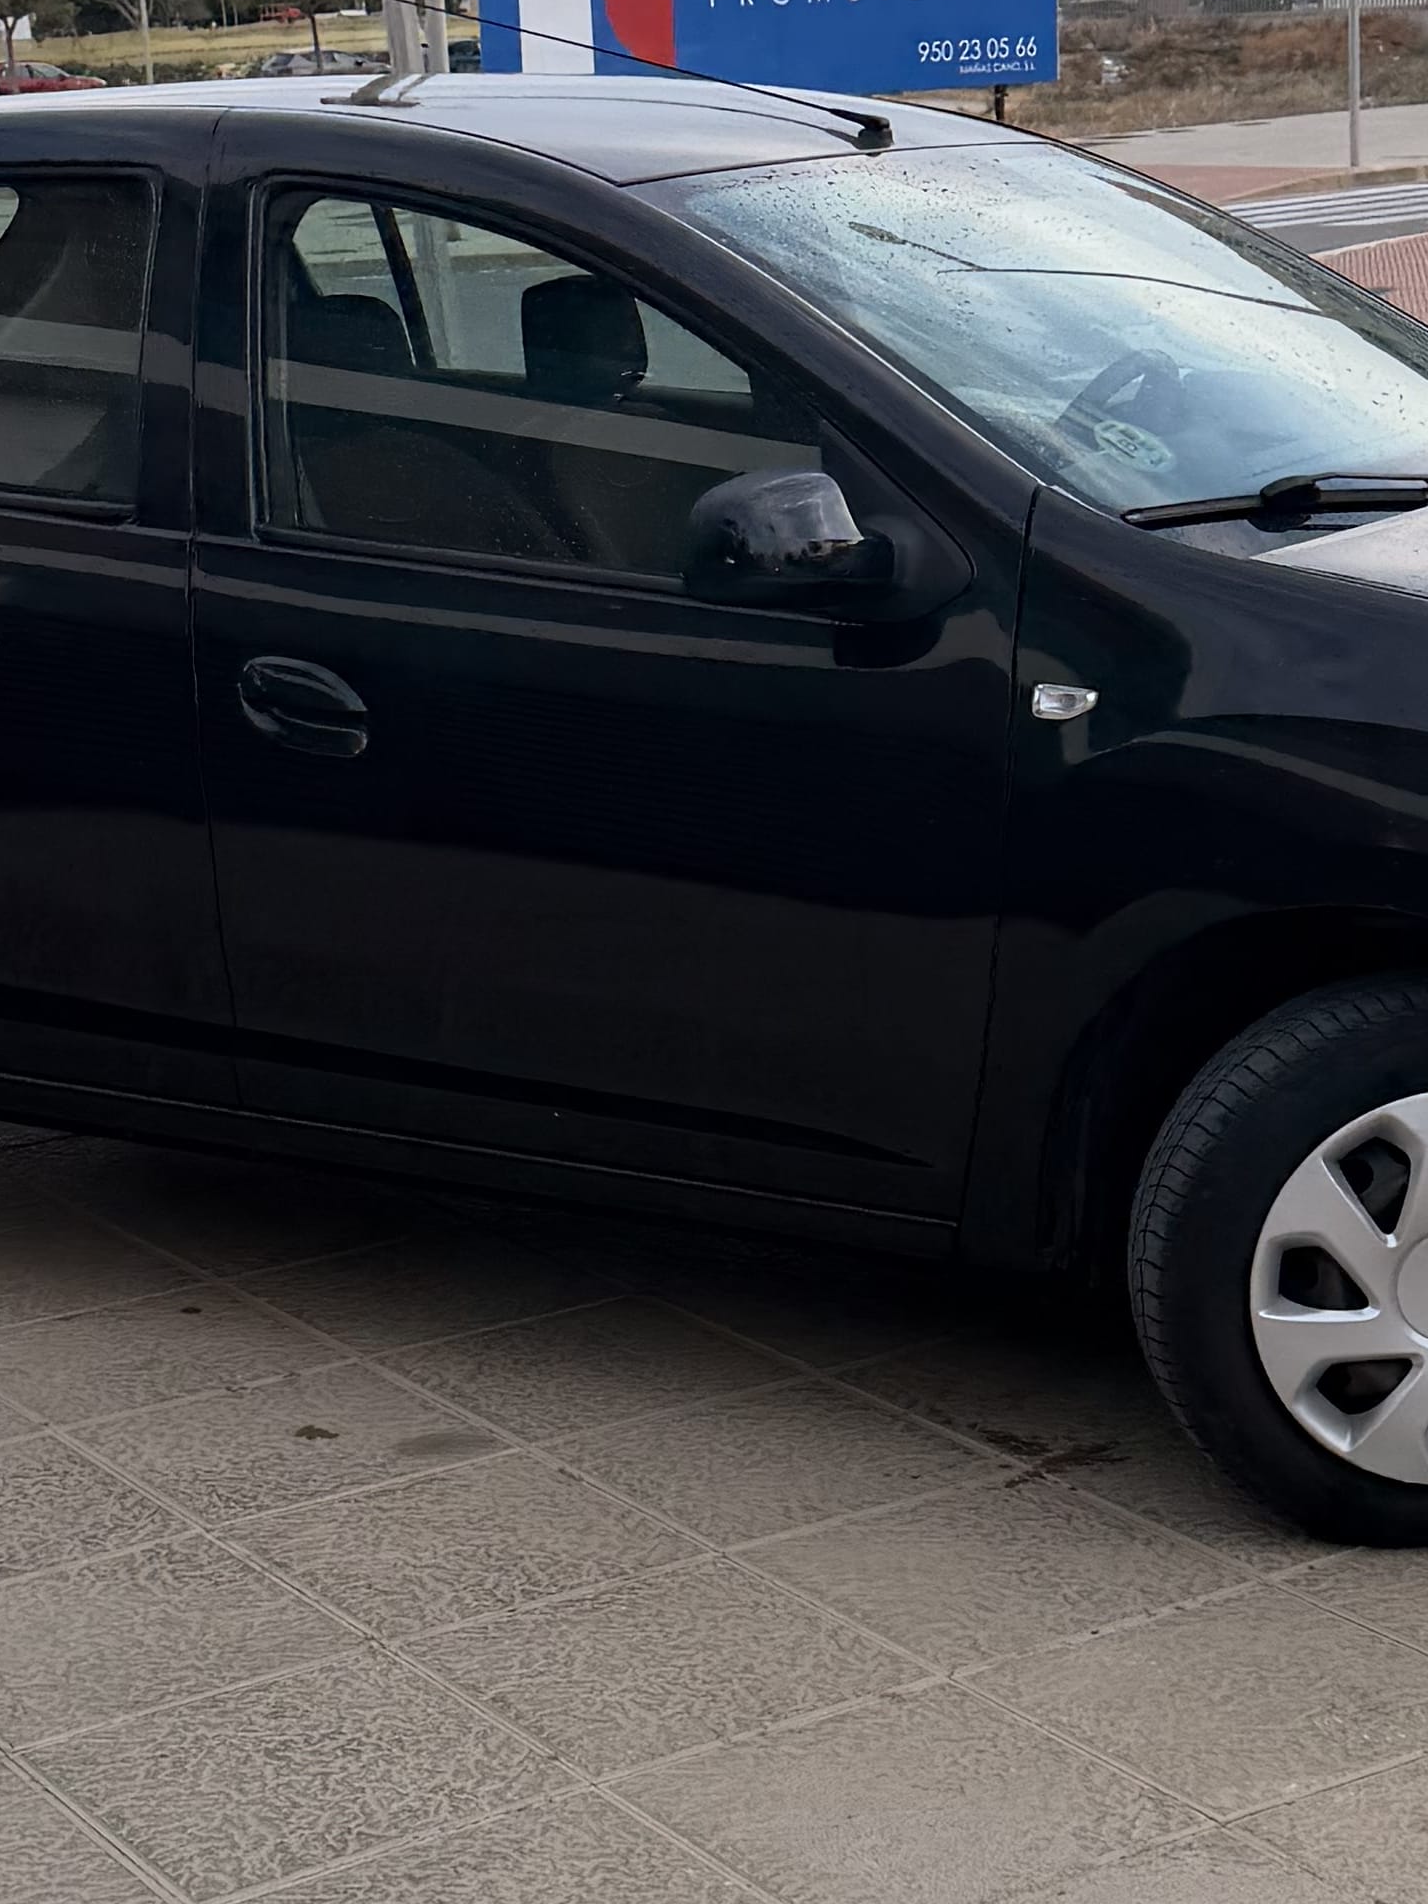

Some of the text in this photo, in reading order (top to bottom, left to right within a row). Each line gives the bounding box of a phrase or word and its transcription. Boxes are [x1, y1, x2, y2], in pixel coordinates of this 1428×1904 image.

[918, 35, 1037, 63] 950 23 05 66
